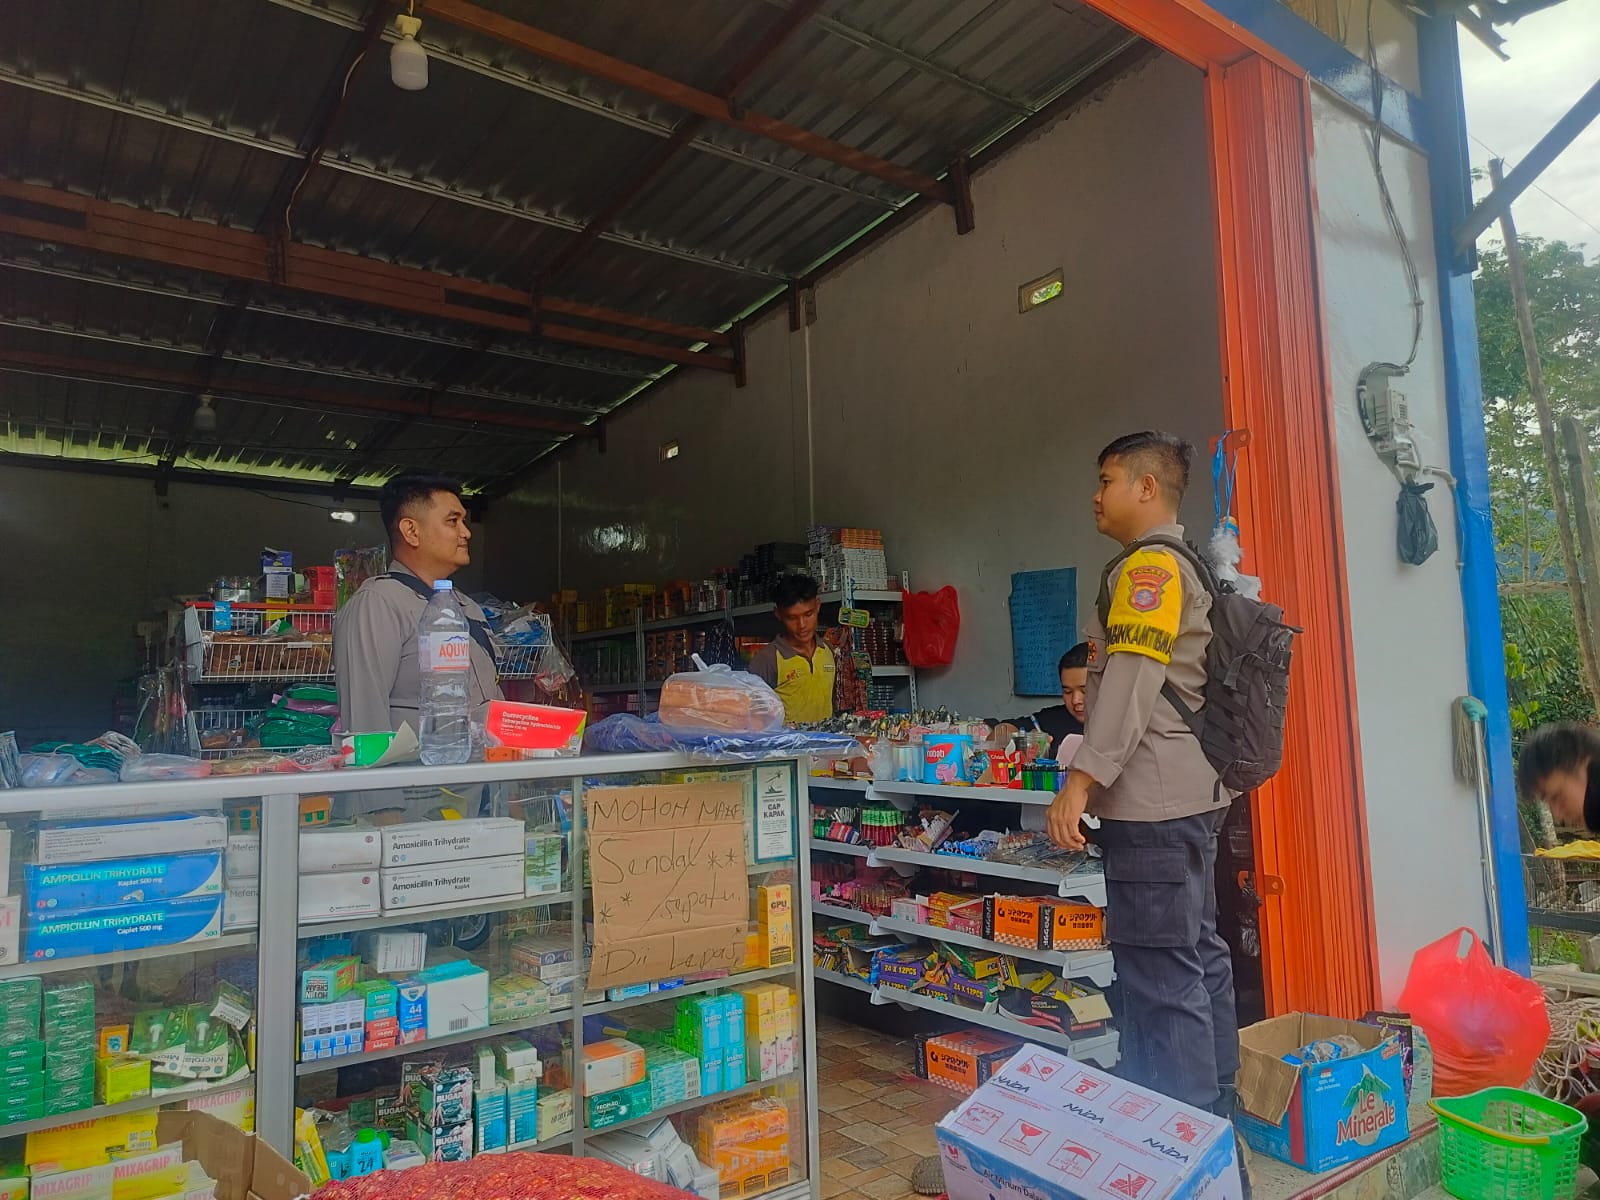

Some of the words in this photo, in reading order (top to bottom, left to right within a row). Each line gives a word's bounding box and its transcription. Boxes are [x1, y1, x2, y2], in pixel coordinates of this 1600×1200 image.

[763, 810, 786, 819] KAPAK
[767, 803, 781, 812] CAP
[392, 839, 433, 851] Amoxicillin
[433, 835, 471, 849] Trihydrate
[42, 870, 102, 885] AMPICILLIN
[103, 866, 165, 879] TRIHYDRATE
[392, 880, 433, 892] Amoxicillin
[433, 876, 471, 889] Trihydrate
[40, 919, 101, 935] AMPICILLIN
[102, 913, 164, 927] TRIHYDRATE
[953, 982, 961, 990] 24
[409, 1004, 422, 1014] 44
[1359, 1089, 1375, 1114] Le
[1336, 1103, 1395, 1146] Minerale
[114, 1156, 170, 1179] MIXAGRIP
[34, 1174, 93, 1197] MIXAGRIP
